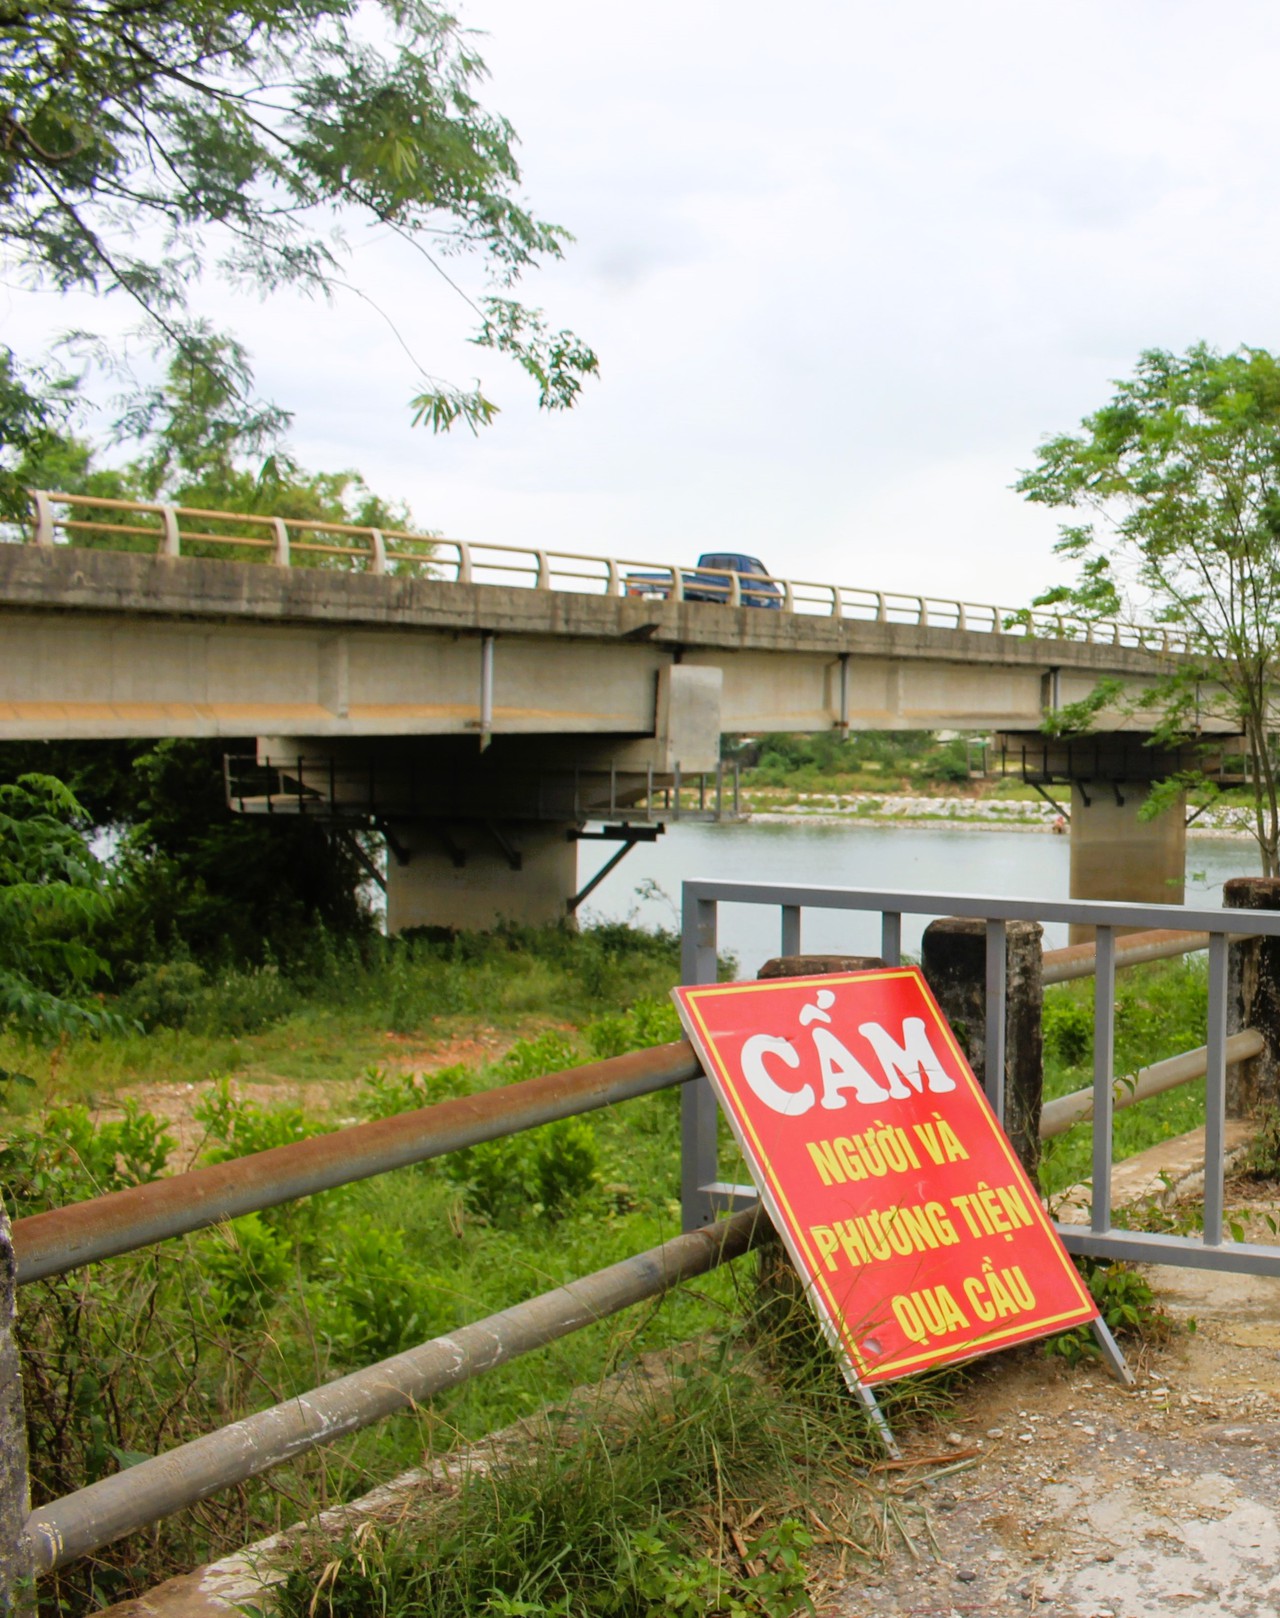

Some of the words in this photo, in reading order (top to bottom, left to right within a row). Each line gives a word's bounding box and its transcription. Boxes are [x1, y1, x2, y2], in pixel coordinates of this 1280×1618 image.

[741, 989, 957, 1116] CẤM
[805, 1120, 922, 1187] NGƯỜI
[912, 1112, 970, 1166] VÀ
[809, 1201, 961, 1273] PHƯƠNG
[950, 1181, 1034, 1242] TIỆN
[891, 1284, 971, 1346] QUA
[963, 1256, 1037, 1323] CẦU
